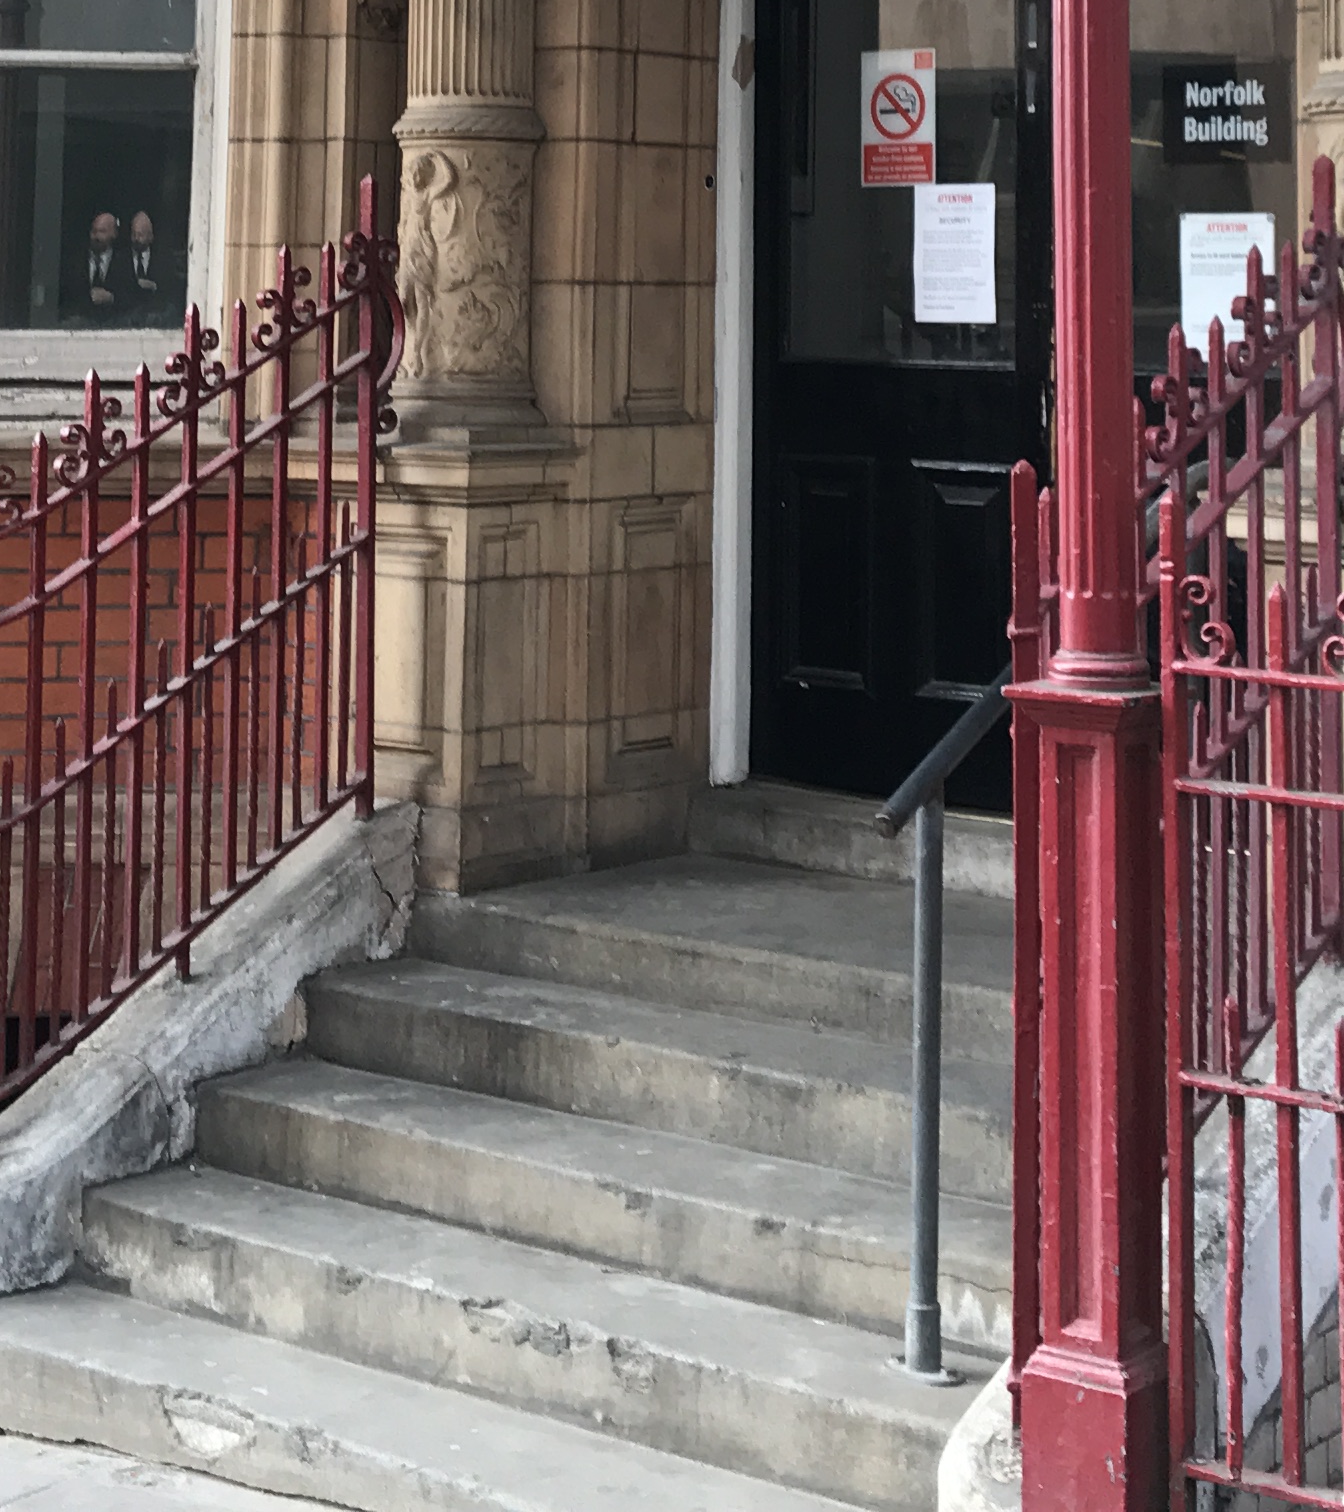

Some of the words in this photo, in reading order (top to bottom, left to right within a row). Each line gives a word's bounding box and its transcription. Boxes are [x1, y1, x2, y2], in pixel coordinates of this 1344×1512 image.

[1186, 79, 1265, 107] Norfolk
[1184, 115, 1268, 146] Building
[937, 193, 973, 204] ATTENTION
[1206, 222, 1248, 232] ATTENTION
